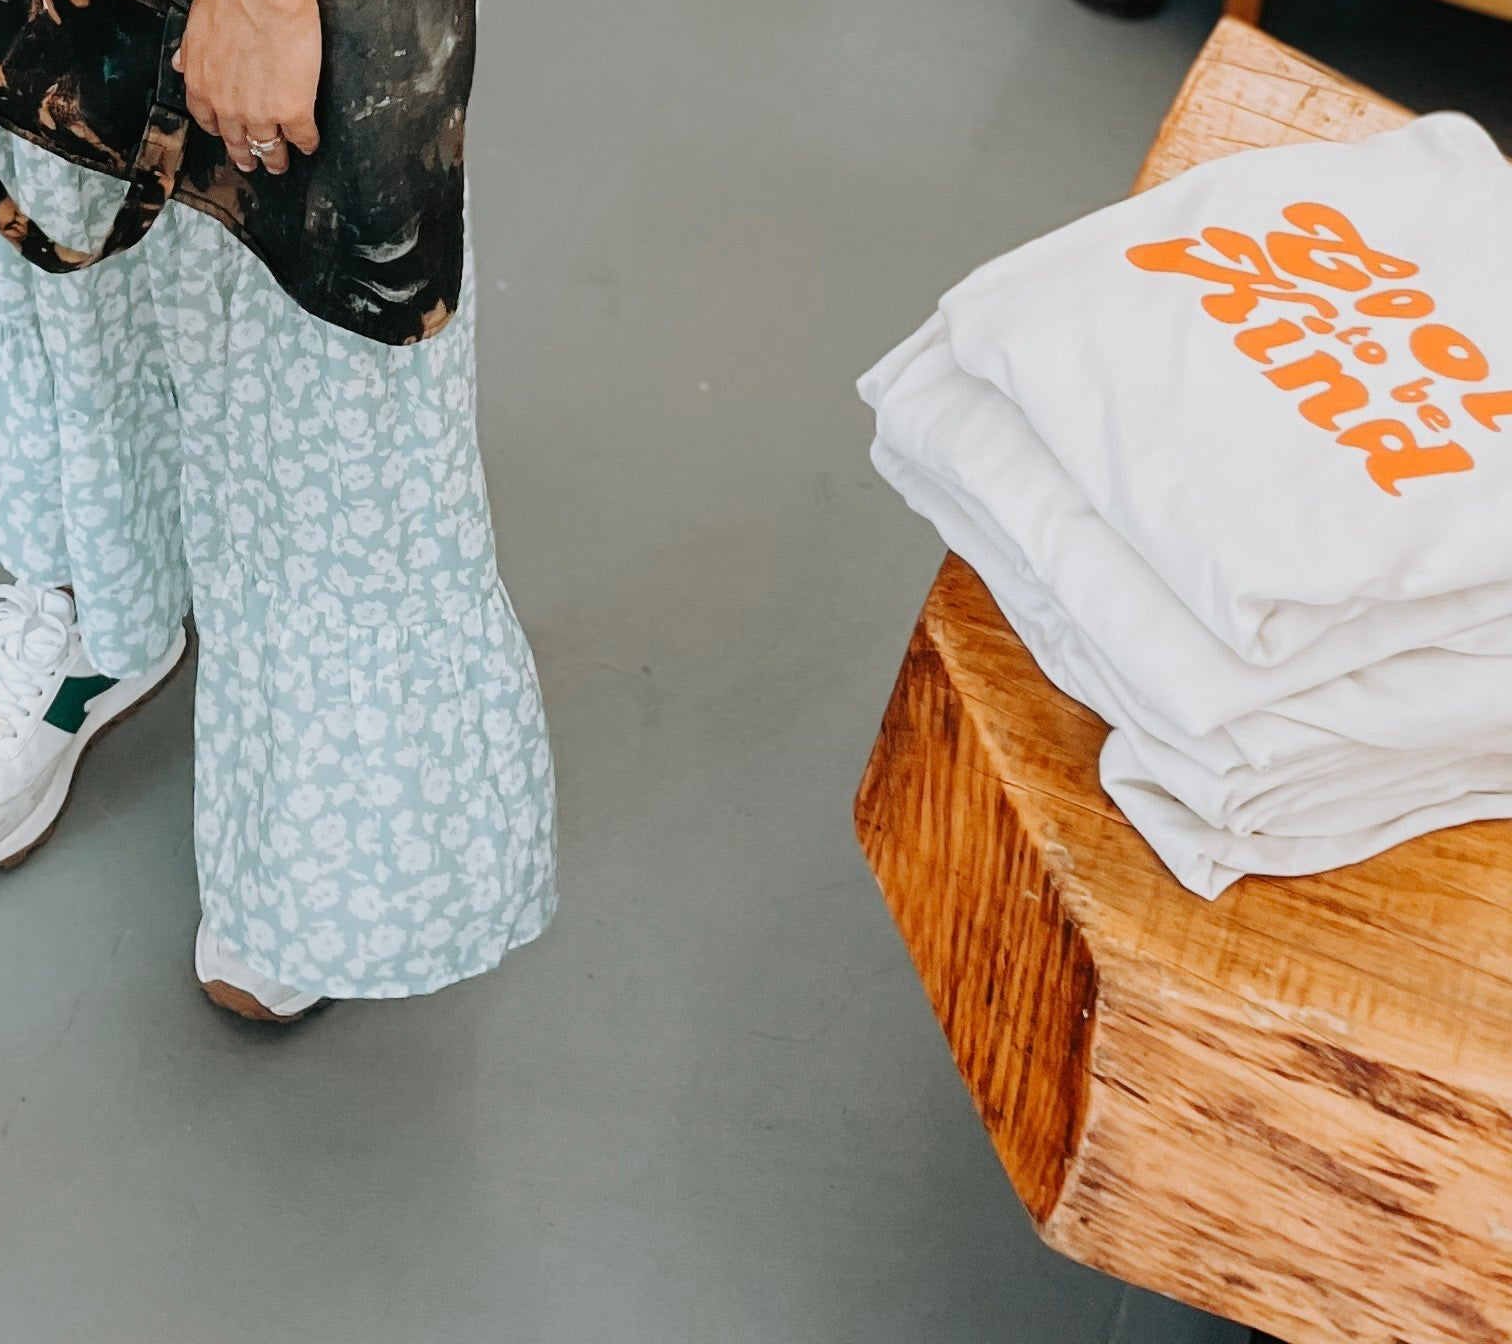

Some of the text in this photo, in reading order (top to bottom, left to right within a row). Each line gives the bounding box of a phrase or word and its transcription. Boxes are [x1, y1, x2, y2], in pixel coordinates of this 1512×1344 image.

[1124, 225, 1475, 497] Kind
[1335, 325, 1452, 433] to be
